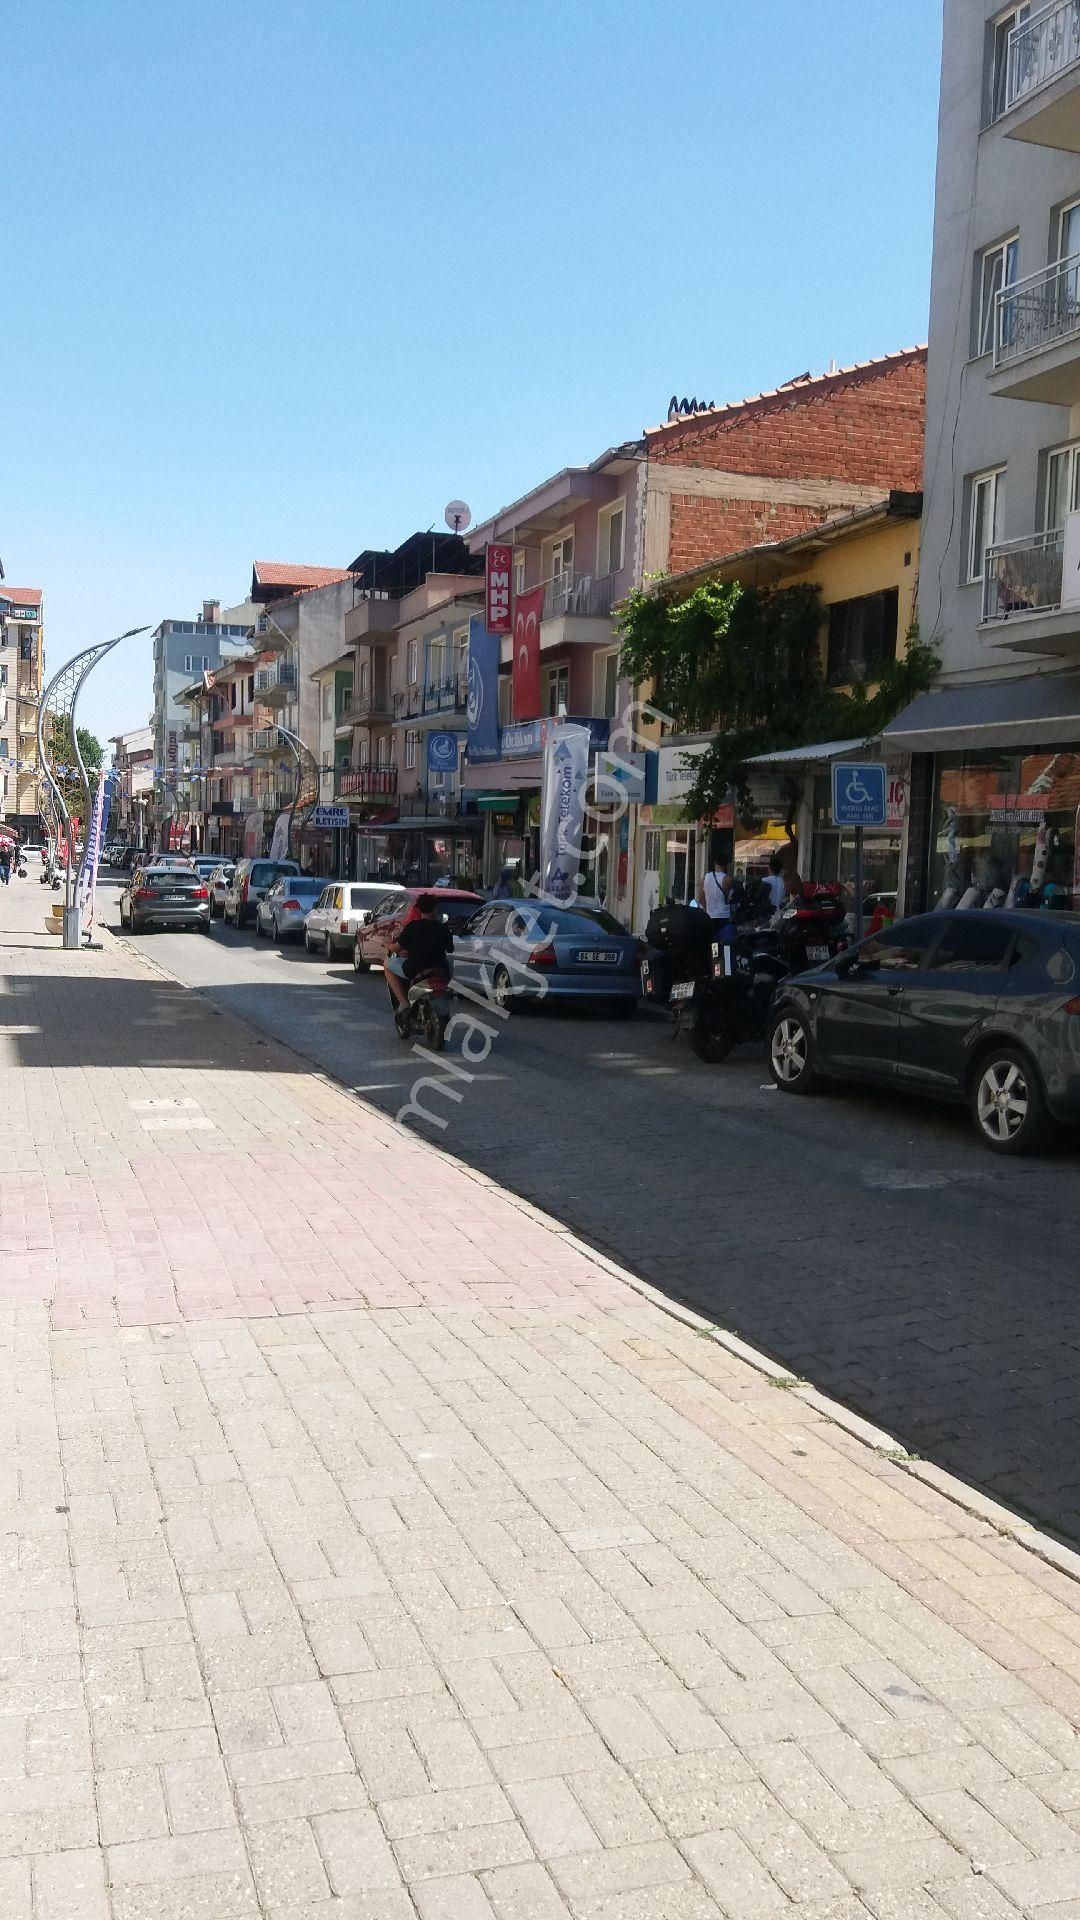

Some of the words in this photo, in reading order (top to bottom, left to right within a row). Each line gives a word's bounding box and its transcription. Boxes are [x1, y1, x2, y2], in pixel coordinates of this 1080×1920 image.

[490, 571, 509, 622] MHP
[665, 771, 678, 782] Türk
[678, 769, 700, 781] Teleko
[557, 766, 573, 823] Telekom
[315, 807, 348, 817] EMRE
